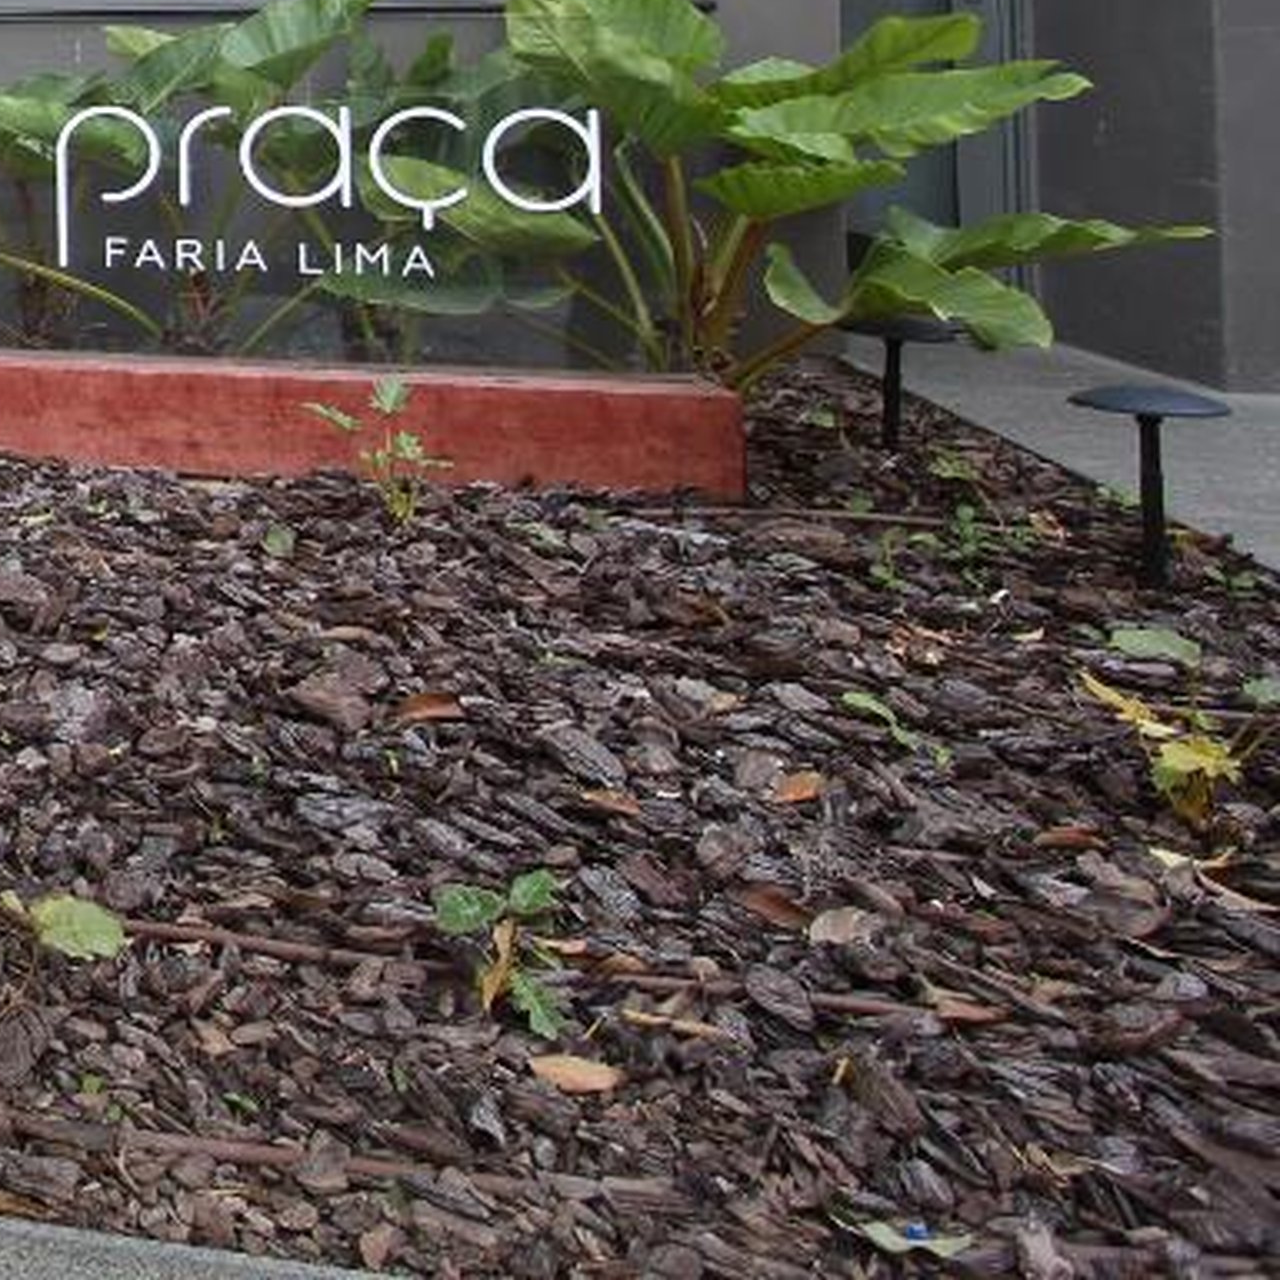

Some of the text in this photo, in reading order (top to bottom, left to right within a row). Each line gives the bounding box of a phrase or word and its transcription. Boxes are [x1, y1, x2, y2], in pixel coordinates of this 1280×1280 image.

[55, 105, 603, 268] praça
[103, 236, 435, 278] FARIA LIMA
